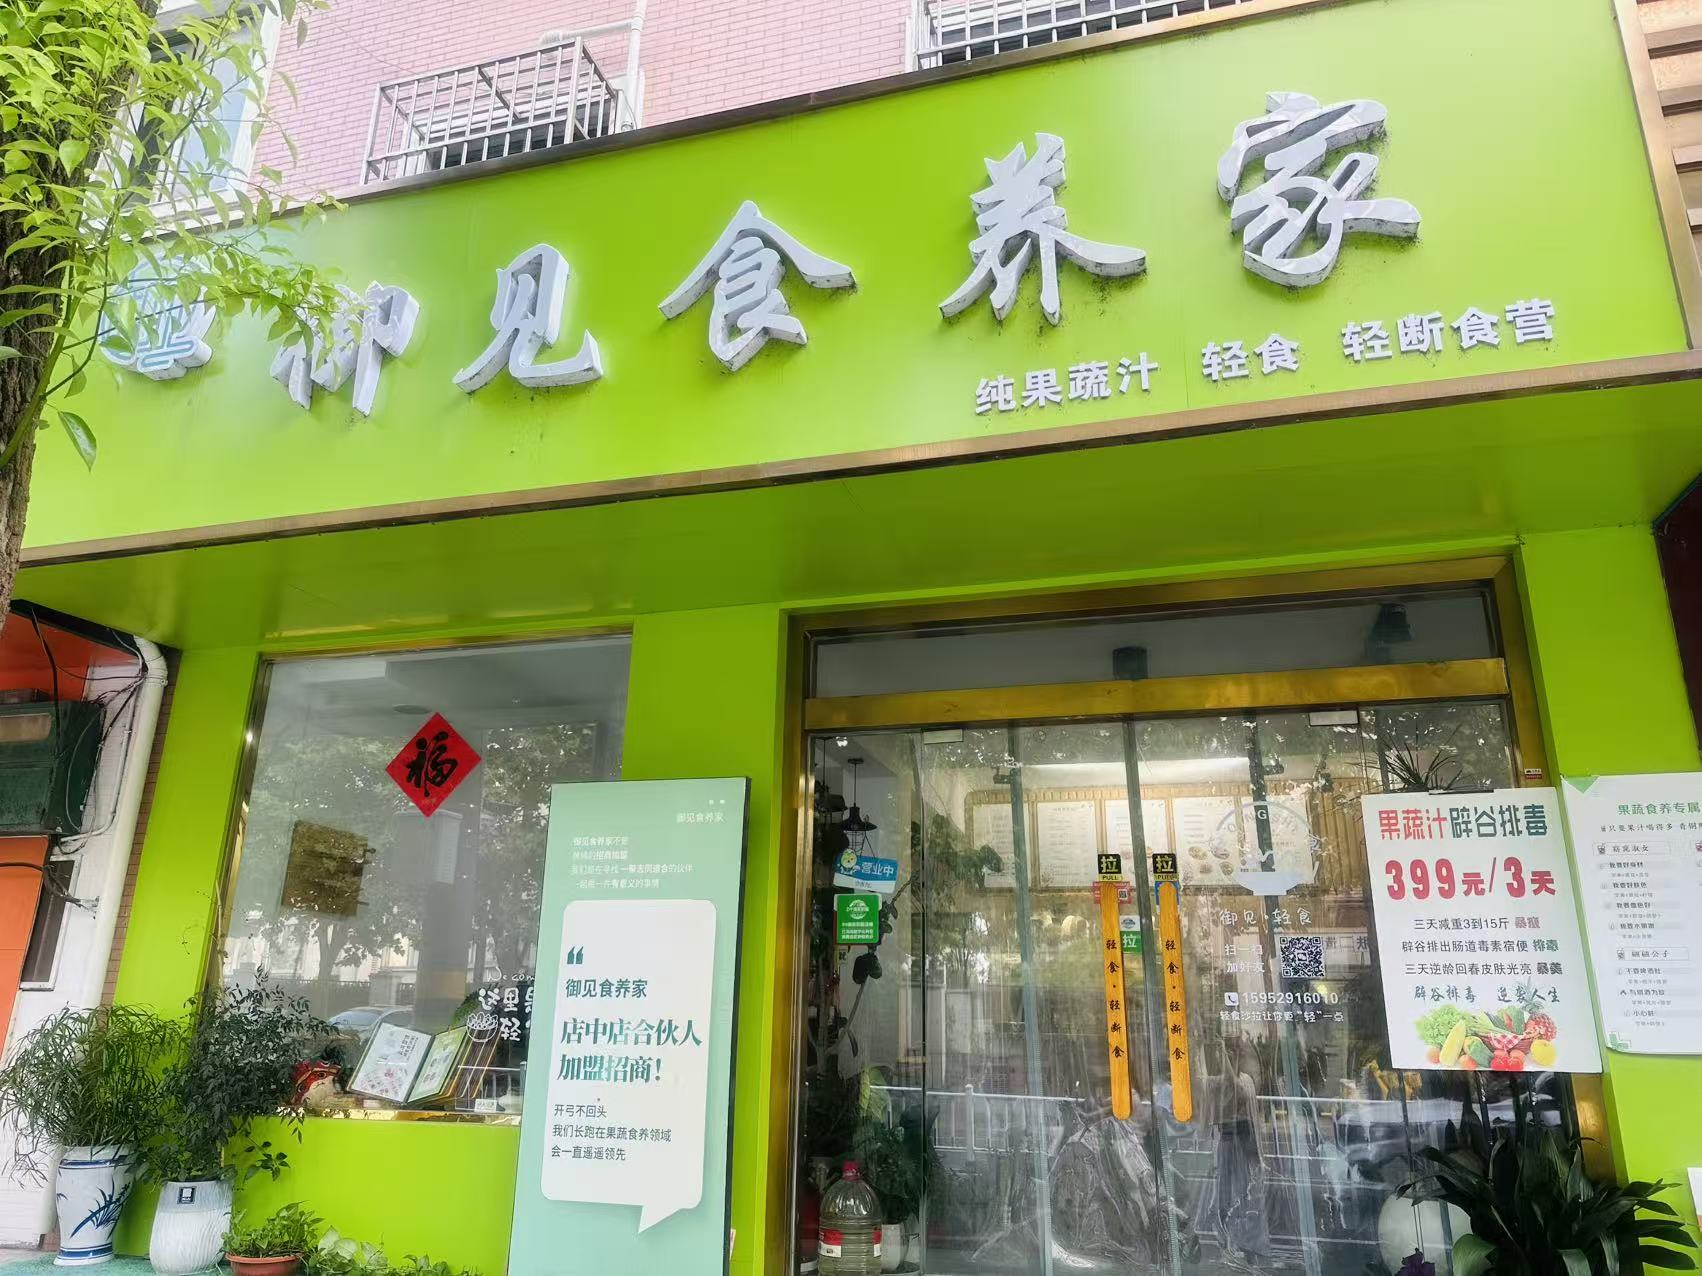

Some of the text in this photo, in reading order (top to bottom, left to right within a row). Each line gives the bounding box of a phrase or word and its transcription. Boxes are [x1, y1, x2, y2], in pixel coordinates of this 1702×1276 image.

[975, 298, 1556, 415] 纯果蔬汁 轻食 轻断食营
[406, 731, 457, 797] 福
[1378, 803, 1548, 841] 果蔬汁辟谷排毒
[861, 861, 895, 878] 营业中
[1101, 855, 1119, 873] 拉
[1156, 855, 1174, 873] 拉
[1384, 856, 1557, 900] 399元/3天
[1413, 917, 1510, 931] 三天减重3到15斤
[1122, 933, 1138, 949] 拉
[1224, 943, 1263, 957] 扫一扫
[1401, 938, 1560, 953] 辟谷排出肠道毒素宿便 排毒
[1226, 961, 1266, 973] 加好友
[1404, 963, 1532, 976] 三天逆龄回春皮肤光亮
[565, 978, 648, 999] 御见食养家
[1413, 984, 1478, 1003] 辟谷排毒
[560, 1017, 703, 1046] 店中店合伙人
[553, 1103, 608, 1119] 开弓不回头
[552, 1124, 672, 1142] 我们长跑在果蔬食养领域
[550, 1145, 627, 1162] 会一直遥遥领先
